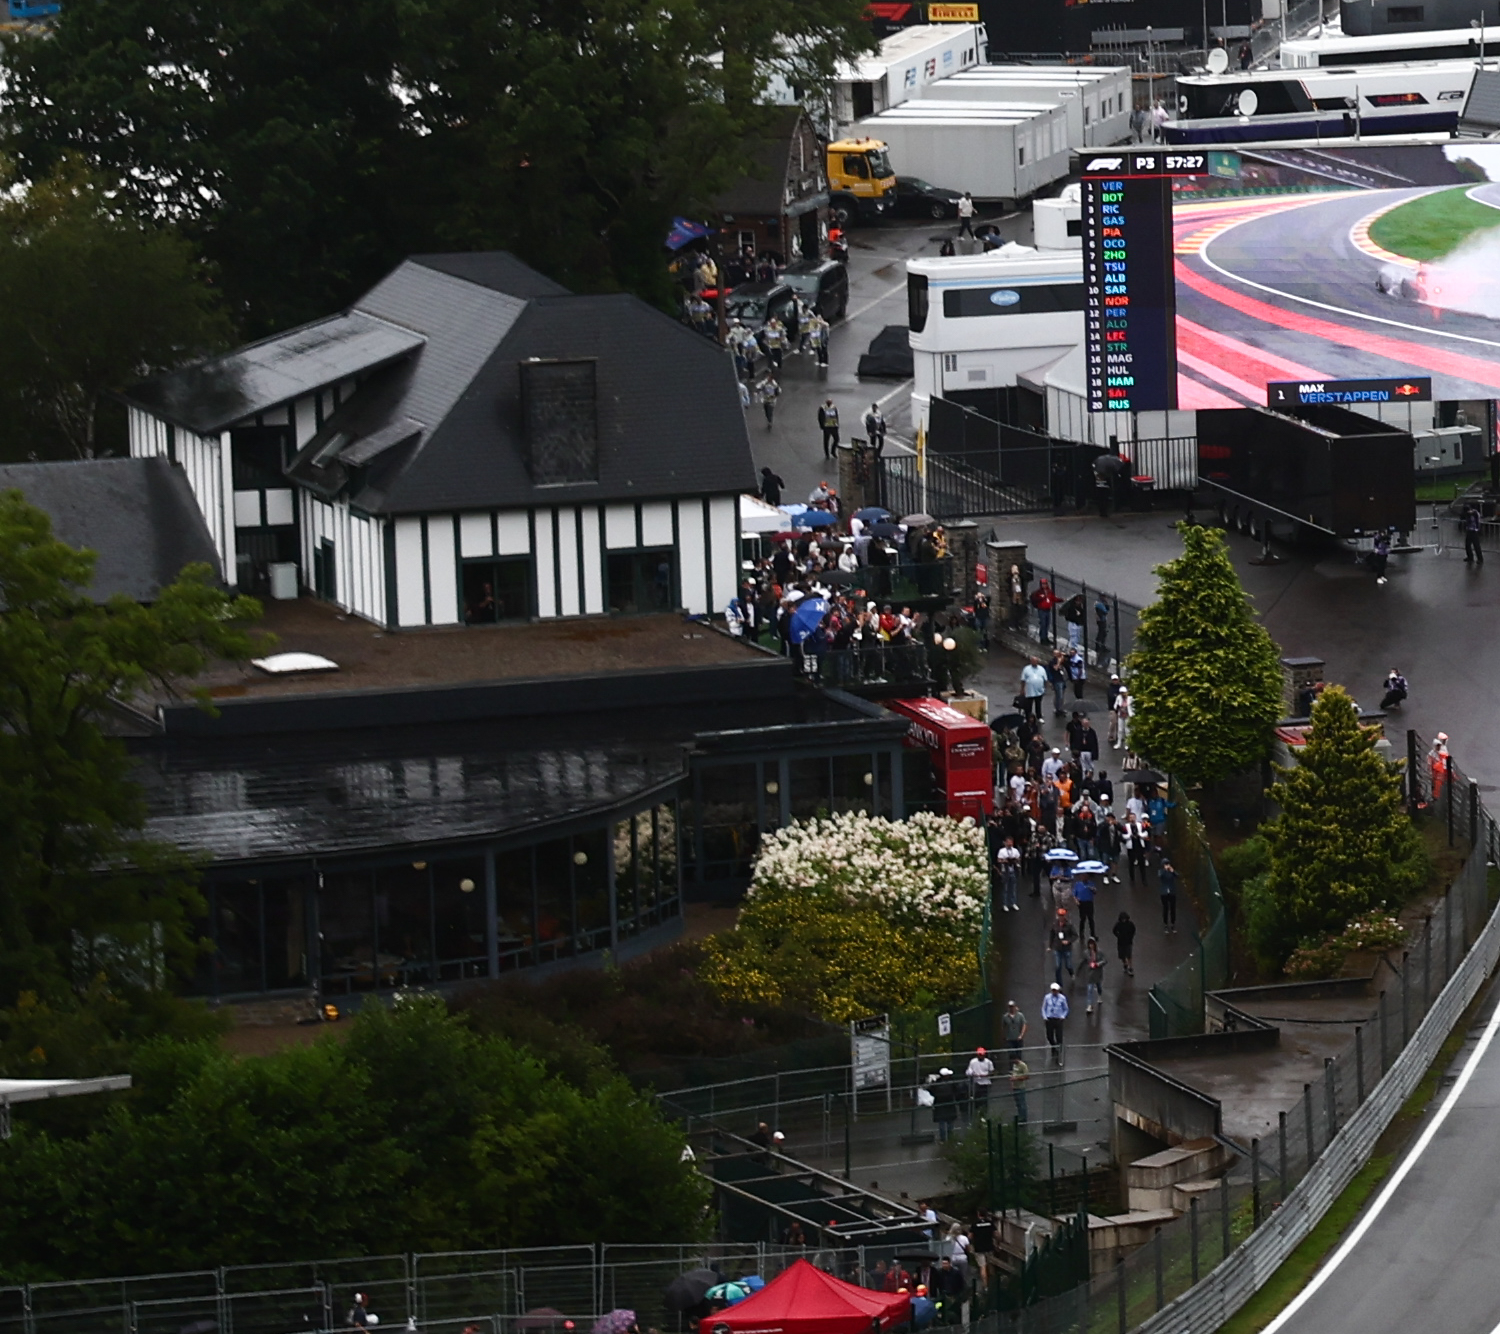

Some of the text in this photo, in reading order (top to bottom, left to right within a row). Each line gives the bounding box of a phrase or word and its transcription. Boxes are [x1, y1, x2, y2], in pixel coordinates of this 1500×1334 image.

[930, 7, 975, 18] PIRELLI
[1136, 157, 1155, 170] P3
[1166, 156, 1204, 169] 57:27
[1102, 182, 1123, 191] VER
[1102, 193, 1124, 202] BOT
[1102, 205, 1120, 214] RIC
[1103, 216, 1125, 225] GAS
[1103, 228, 1122, 237] PIA
[1103, 239, 1126, 248] OCO
[1104, 251, 1126, 259] ZHO
[1104, 262, 1126, 271] TSU
[1105, 274, 1126, 282] ALB
[1089, 285, 1127, 294] 10 SAR
[1089, 296, 1129, 306] 11 NOR
[1106, 308, 1126, 317] PER
[1090, 320, 1127, 329] 13 ALO
[1090, 331, 1126, 341] 14 LEC
[1090, 343, 1128, 352] 15 STR
[1091, 354, 1133, 363] 16 MAG
[1091, 366, 1129, 375] 17 HUL
[1092, 377, 1134, 386] 18 HAM
[1299, 384, 1325, 394] MAX
[1092, 390, 1102, 398] 19
[1300, 390, 1389, 403] VERSTAPPEN
[1092, 400, 1130, 409] 20 RUS
